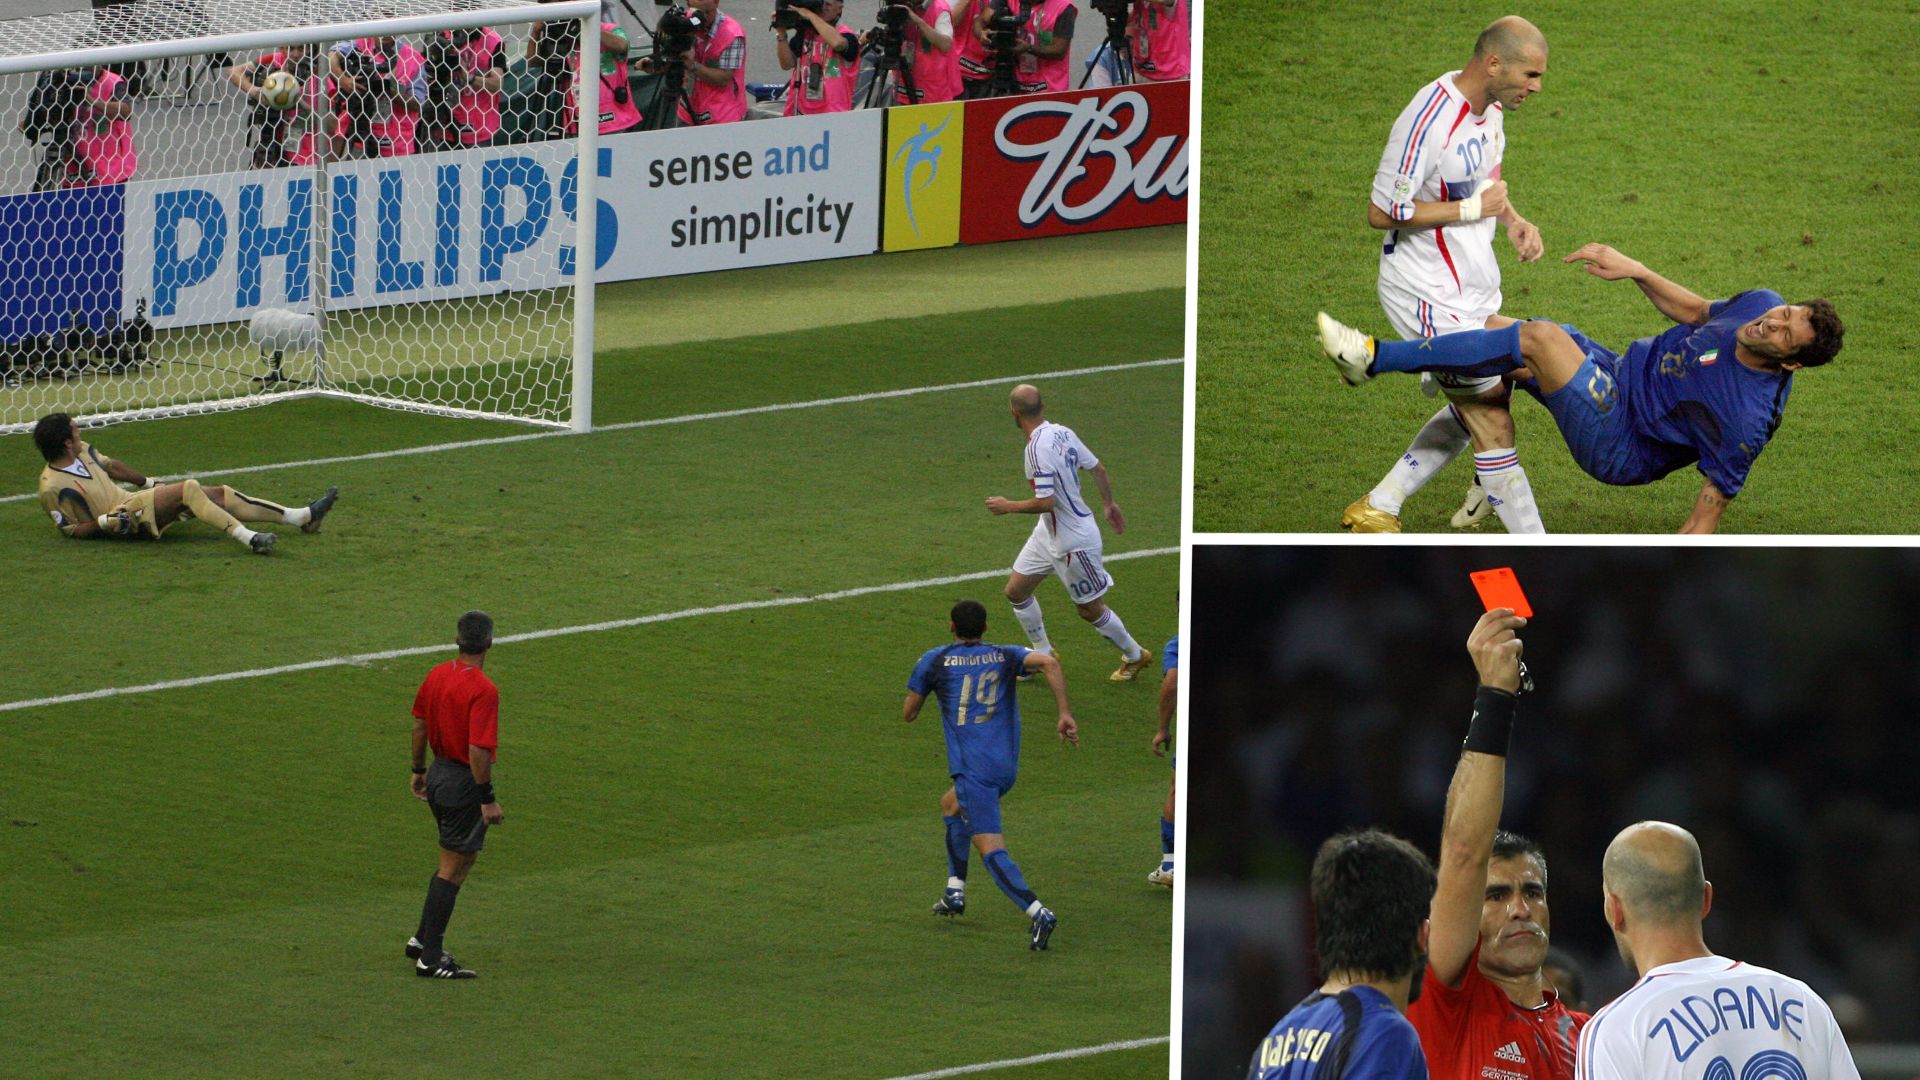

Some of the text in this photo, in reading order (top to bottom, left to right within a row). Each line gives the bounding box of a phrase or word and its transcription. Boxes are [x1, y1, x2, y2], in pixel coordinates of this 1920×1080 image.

[649, 130, 830, 188] sense and
[1456, 137, 1483, 176] 10
[152, 147, 619, 317] PHILIPS
[671, 193, 854, 254] simplicity
[1070, 579, 1092, 598] 10
[943, 652, 1006, 667] zambrotta
[957, 671, 1001, 726] 19
[1648, 985, 1804, 1063] ZIDANE
[1493, 1050, 1526, 1064] adidas
